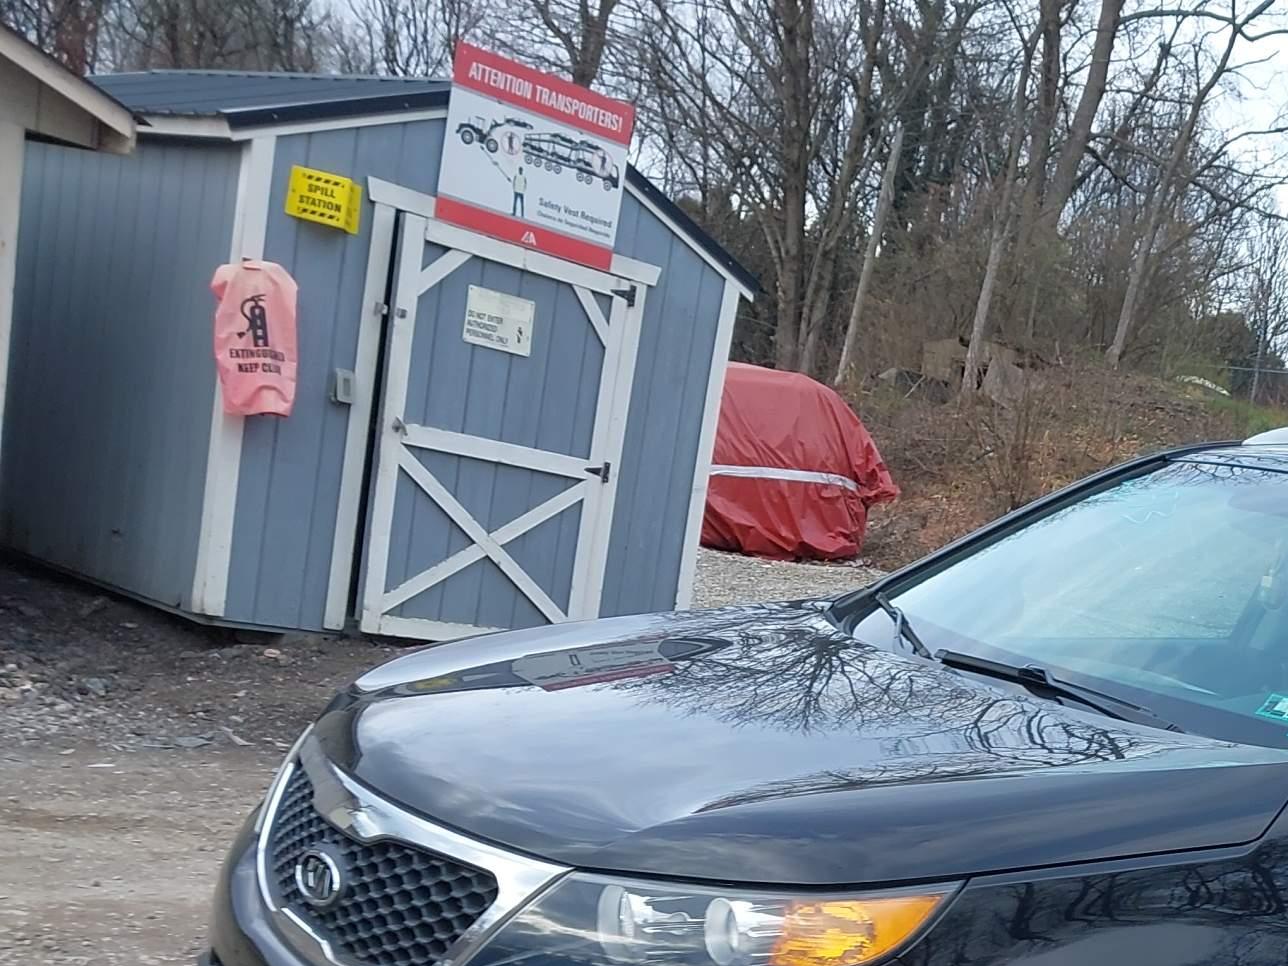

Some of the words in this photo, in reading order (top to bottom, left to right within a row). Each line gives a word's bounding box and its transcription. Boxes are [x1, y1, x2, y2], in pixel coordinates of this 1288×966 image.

[468, 62, 532, 99] ATTENTION
[536, 85, 622, 132] TRANSPORTERS!
[307, 183, 336, 199] SPILL
[299, 195, 342, 213] STATION
